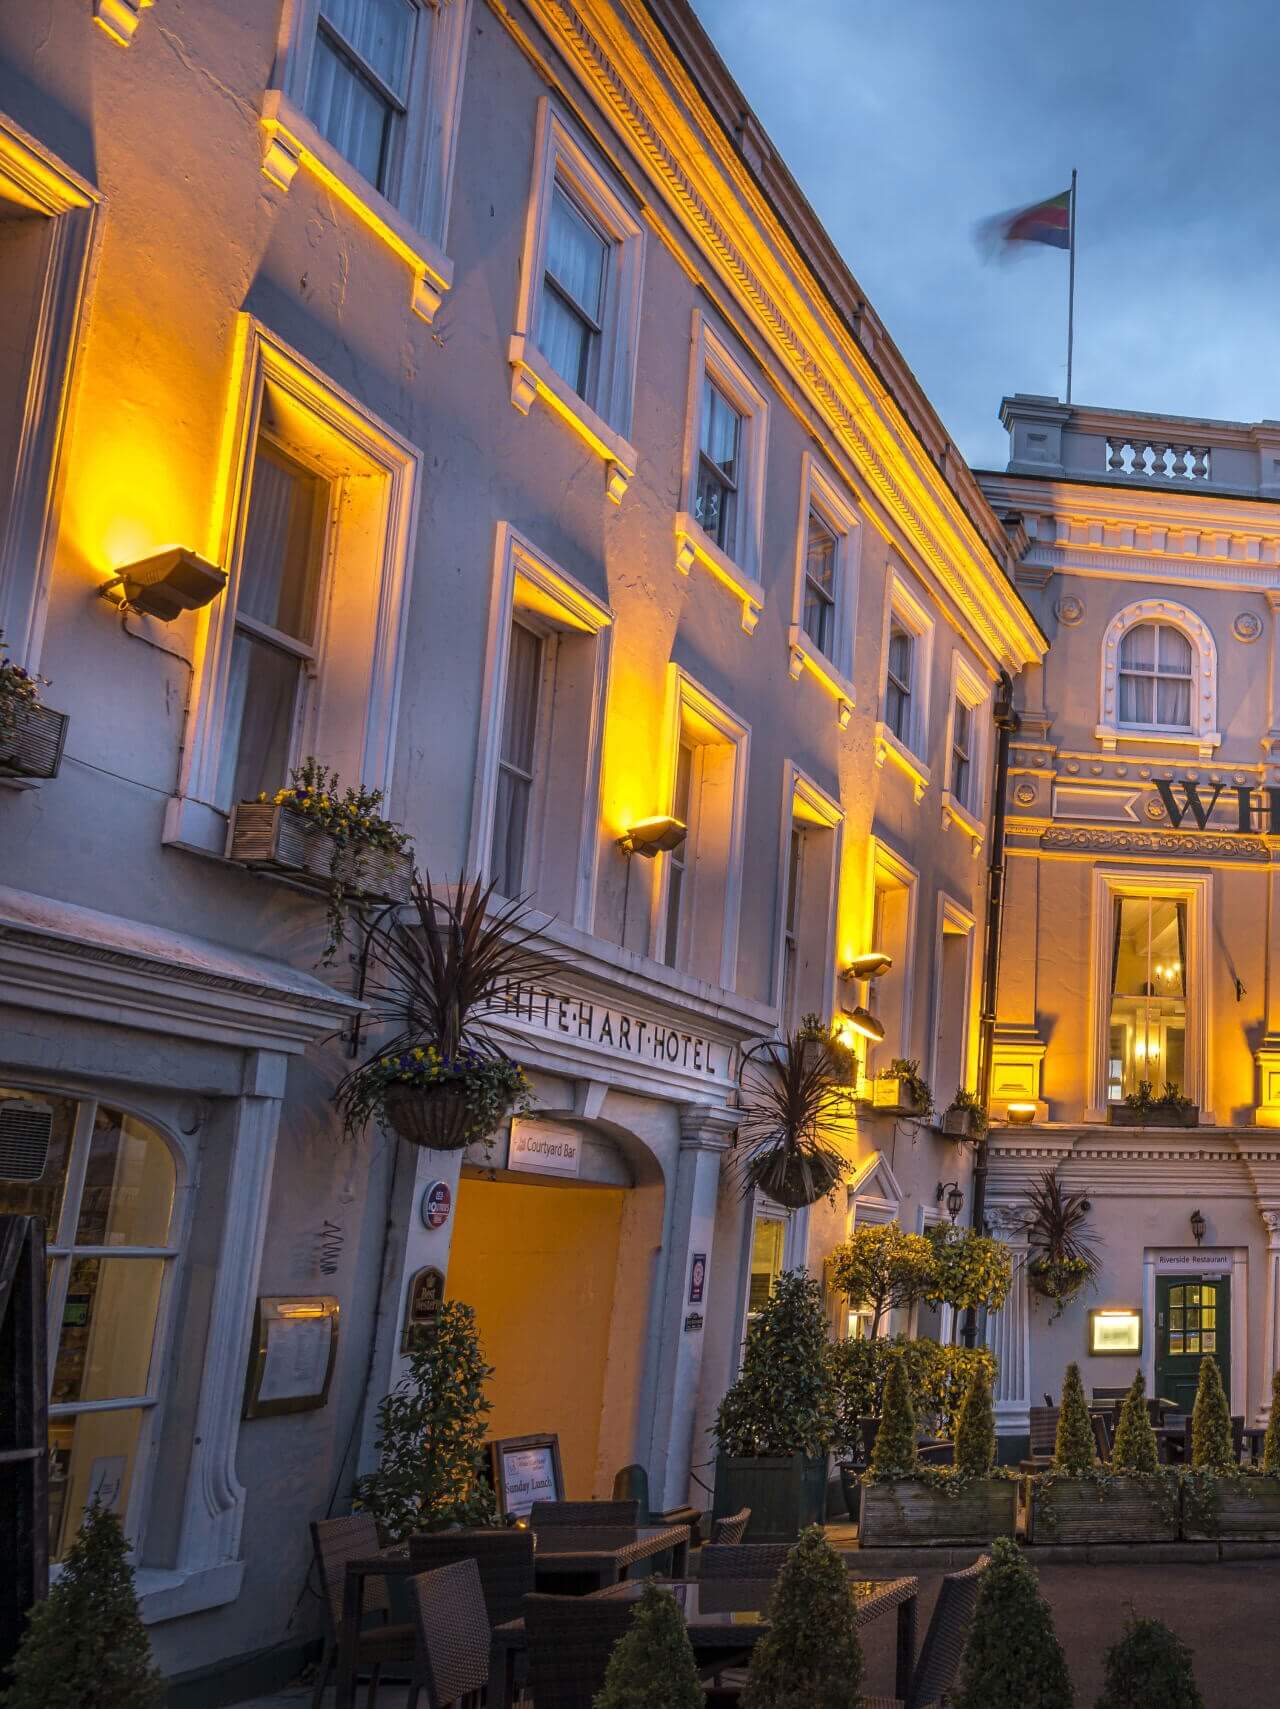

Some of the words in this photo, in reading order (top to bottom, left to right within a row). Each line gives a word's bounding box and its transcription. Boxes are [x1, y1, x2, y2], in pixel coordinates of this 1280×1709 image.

[484, 976, 571, 1033] HITE
[577, 1001, 647, 1055] HART
[653, 1026, 716, 1074] HOTEL
[526, 1136, 563, 1158] Courtyard
[563, 1143, 577, 1159] Bar
[1159, 1255, 1190, 1264] Riverside
[1192, 1255, 1228, 1264] Restaurant
[504, 1479, 530, 1495] Sunday
[531, 1476, 553, 1490] Lunch
